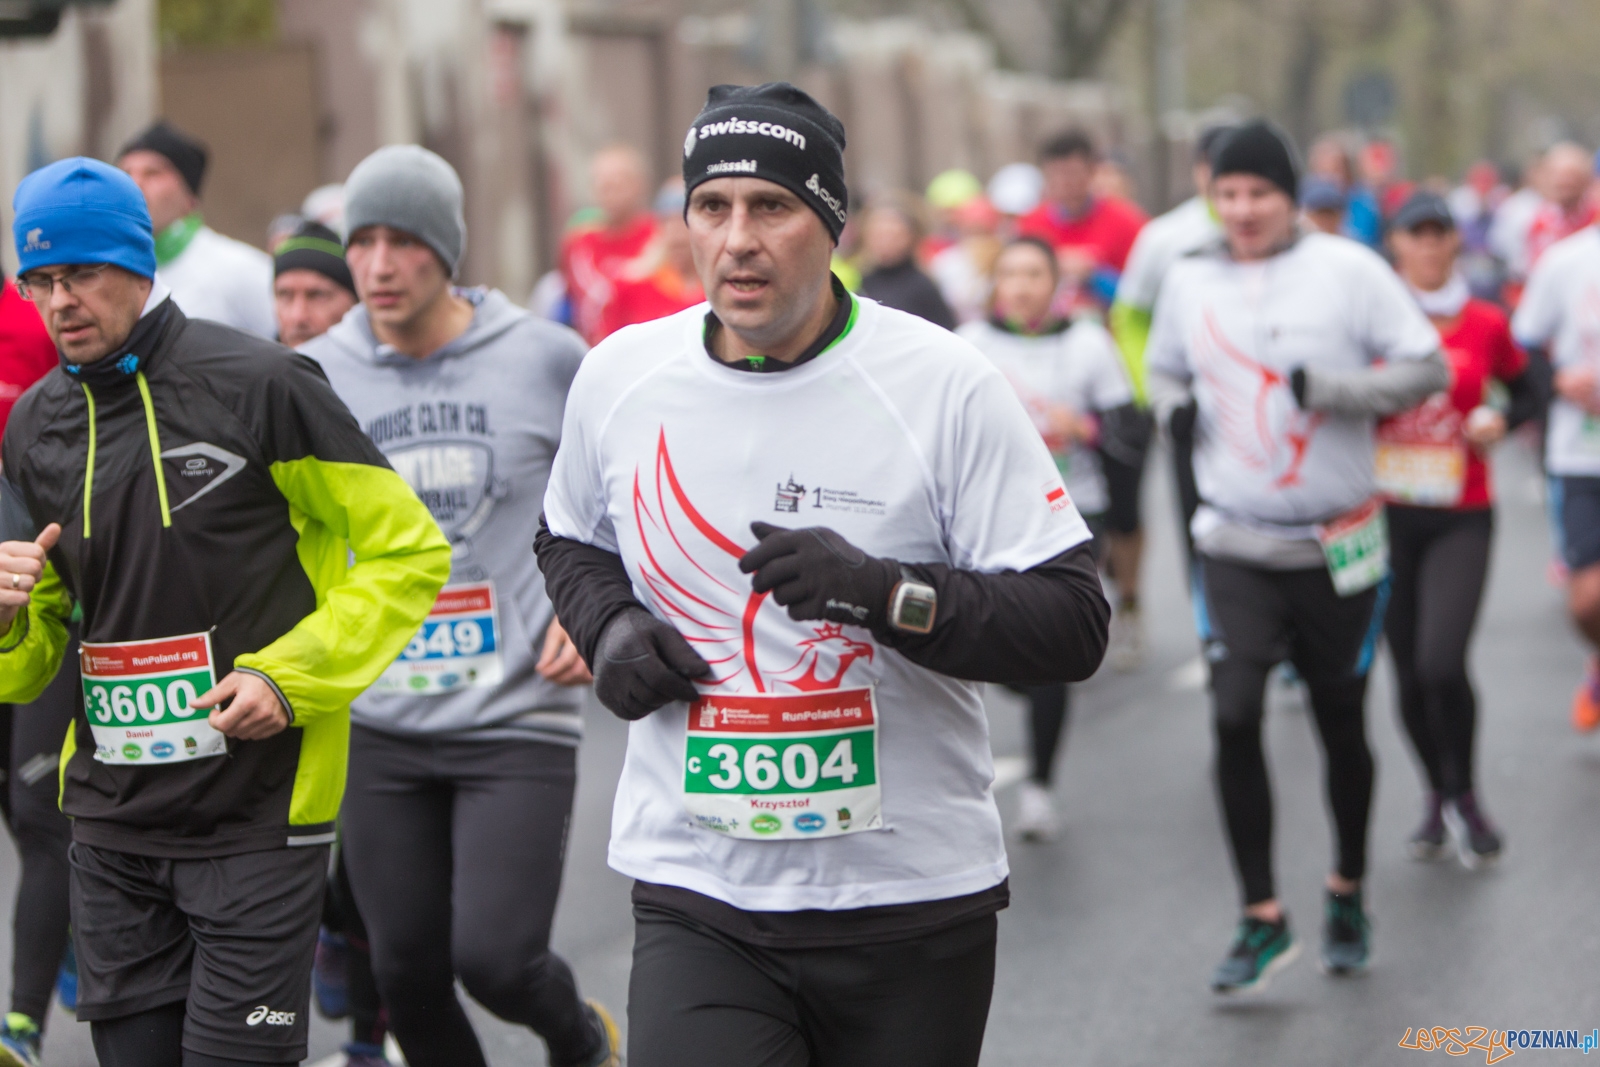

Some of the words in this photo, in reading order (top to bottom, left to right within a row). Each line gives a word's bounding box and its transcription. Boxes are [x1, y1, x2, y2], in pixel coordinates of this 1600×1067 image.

[699, 117, 806, 151] swisscom
[131, 651, 199, 666] RunPoland.org
[91, 679, 198, 724] 3600
[781, 706, 862, 723] RunPoland.org
[125, 730, 154, 739] Daniel
[707, 738, 859, 791] 3604
[750, 798, 811, 811] Krzysztof
[265, 1010, 297, 1026] asics
